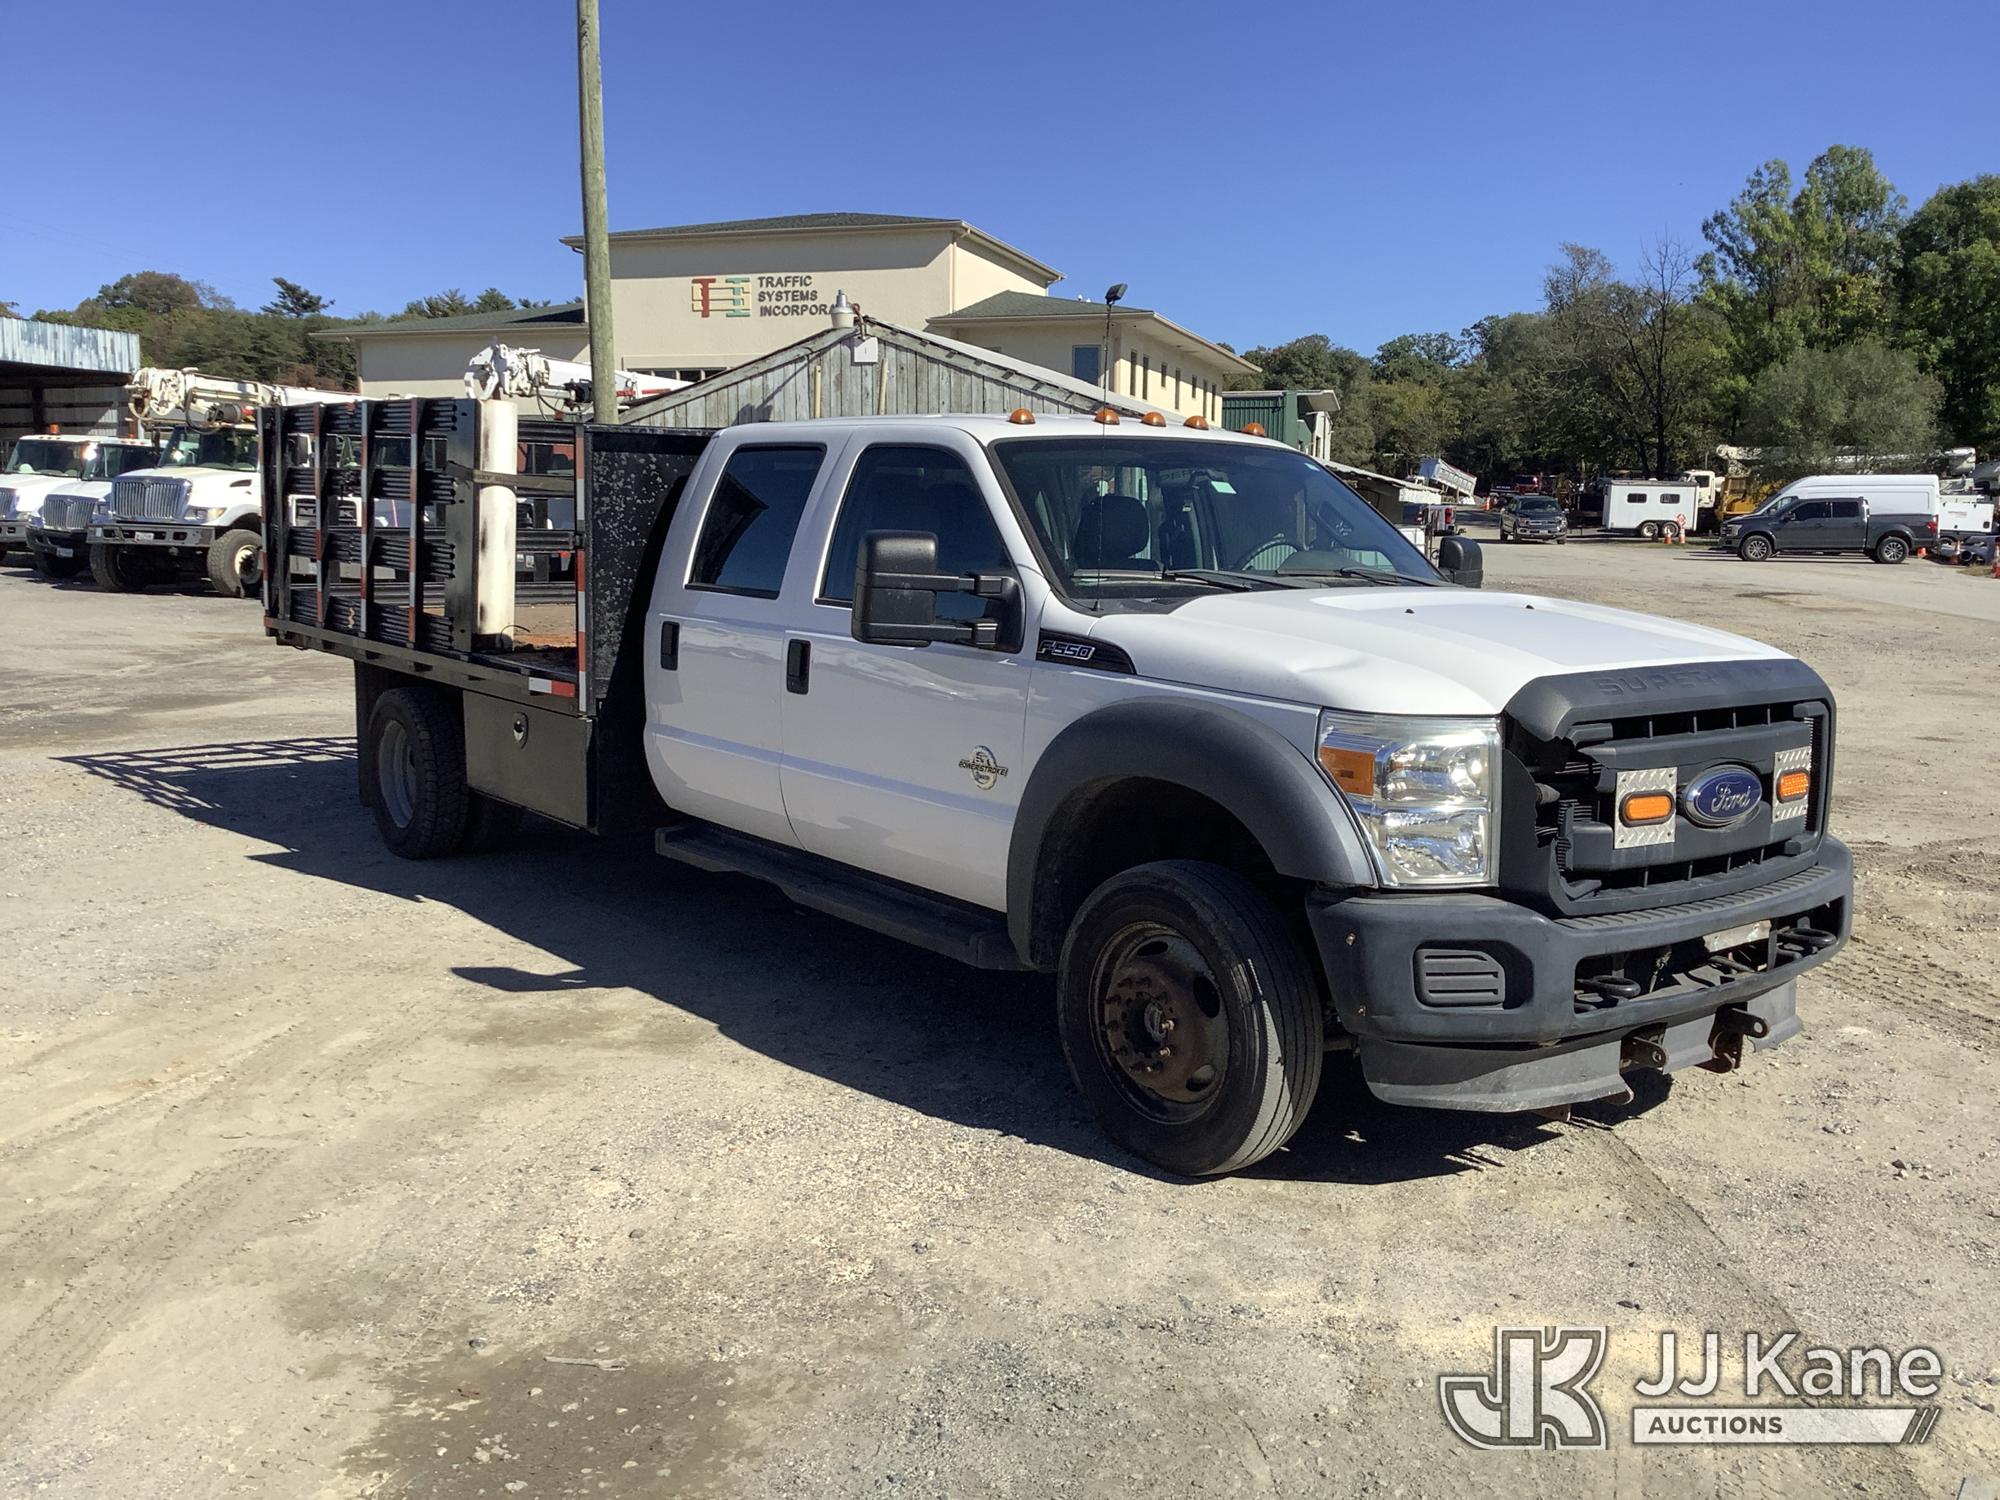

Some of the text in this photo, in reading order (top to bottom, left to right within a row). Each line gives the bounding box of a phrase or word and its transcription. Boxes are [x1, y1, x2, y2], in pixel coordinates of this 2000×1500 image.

[758, 275, 812, 288] TRAFFIC
[758, 290, 818, 302] SYSTEMS
[1711, 781, 1751, 812] Ford
